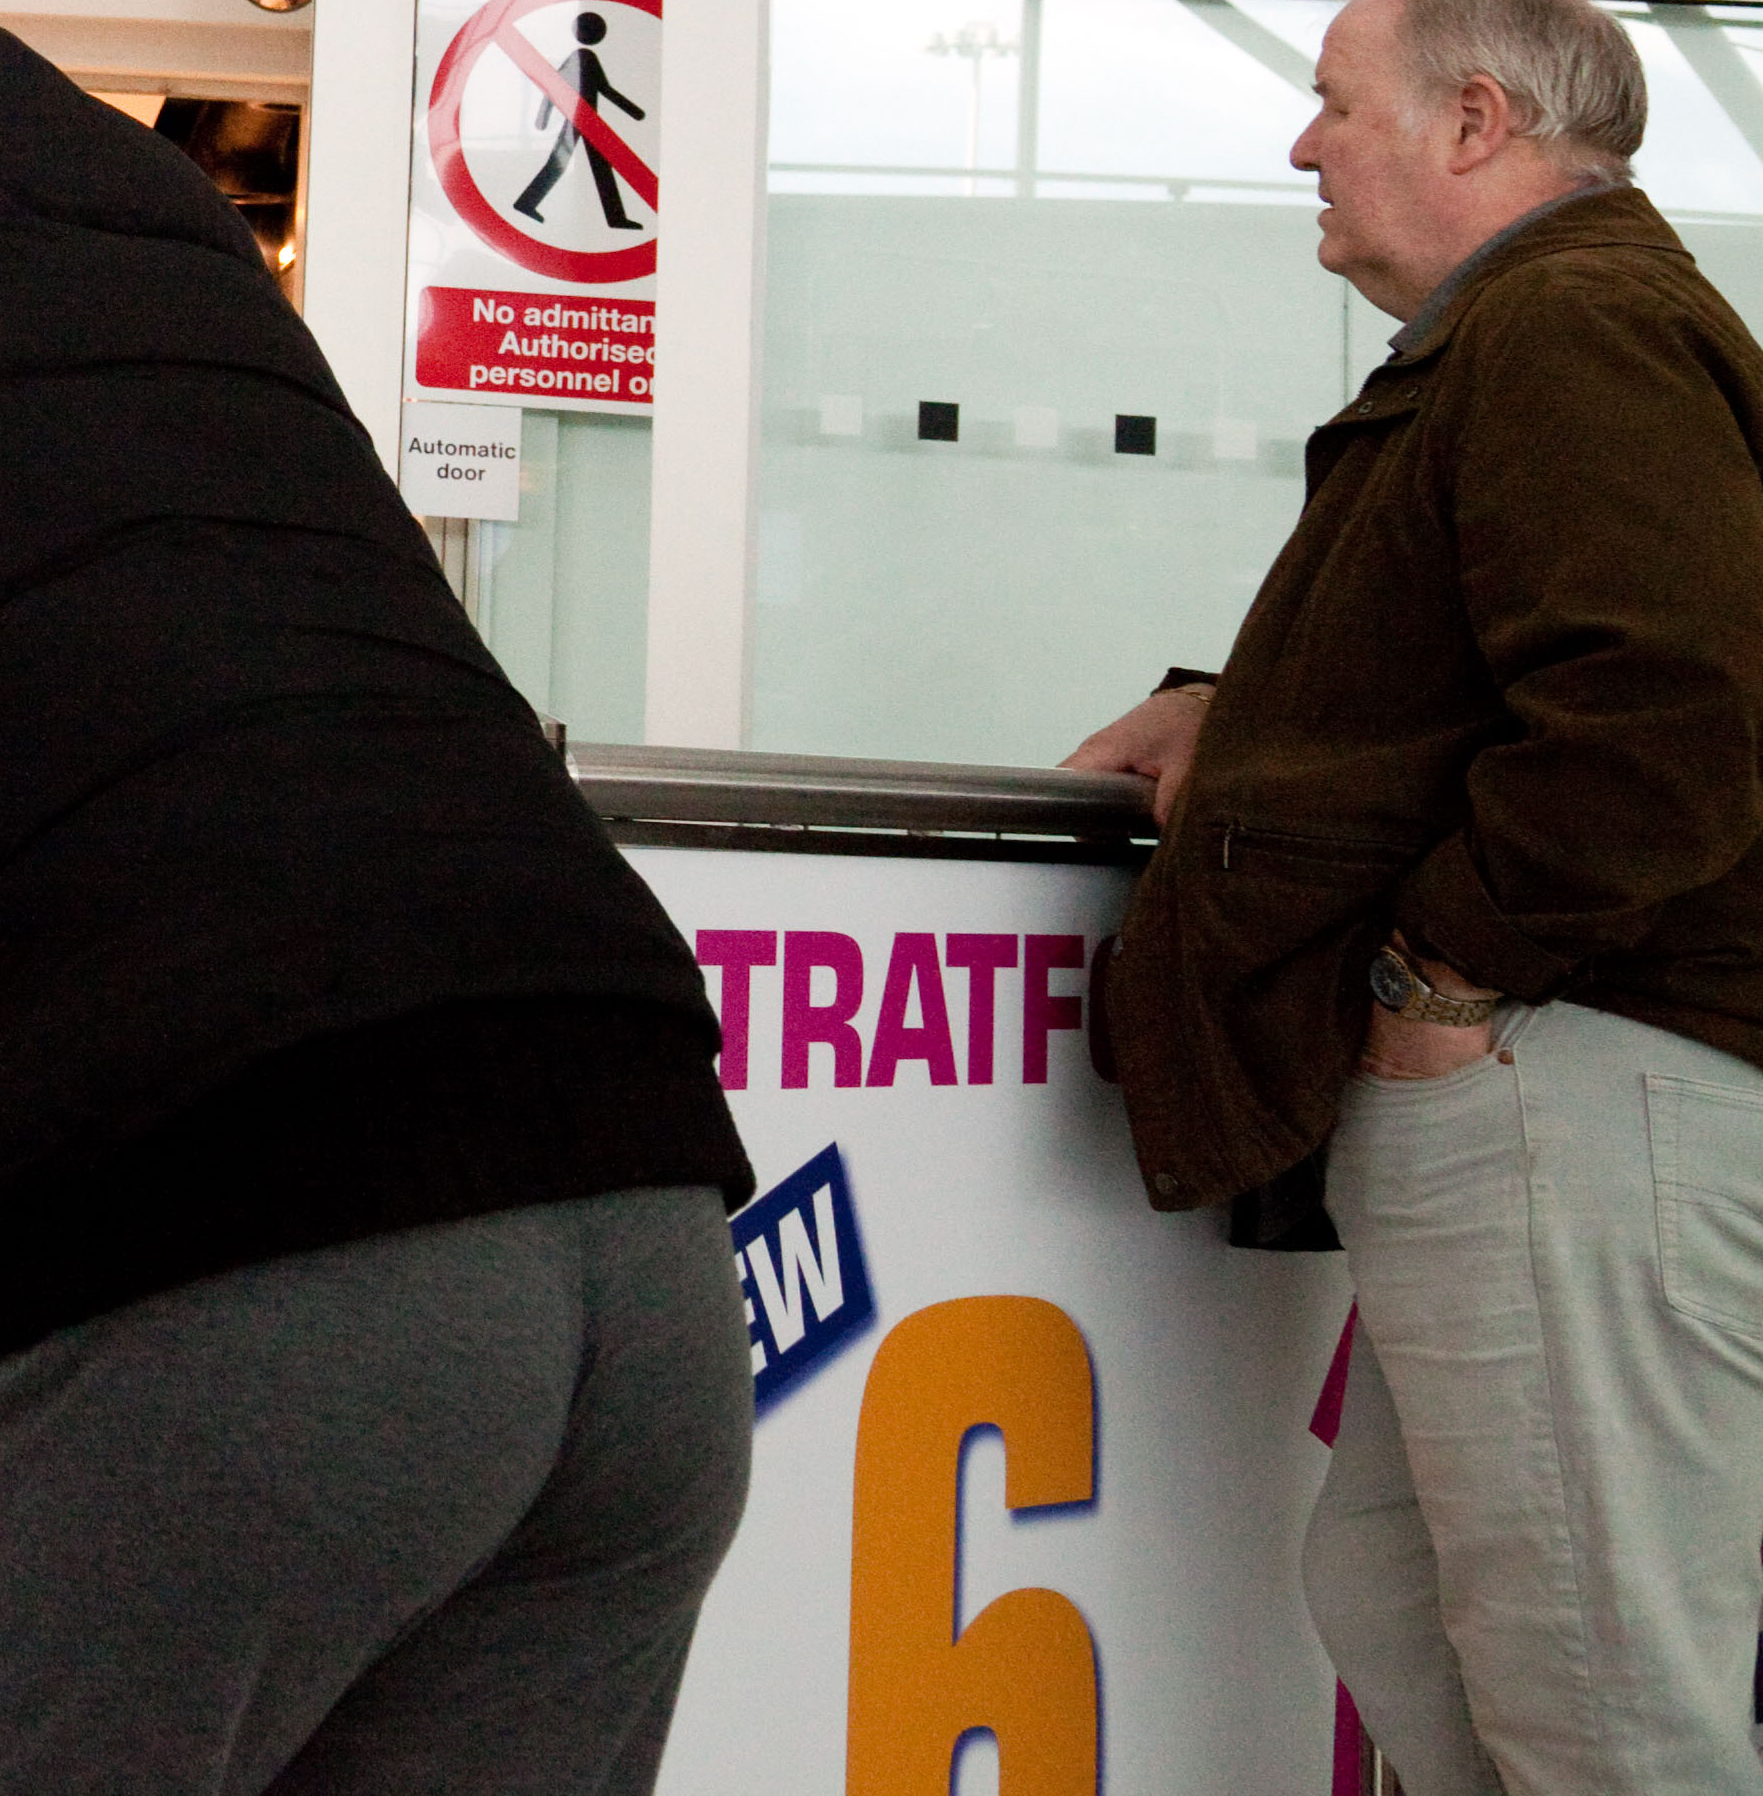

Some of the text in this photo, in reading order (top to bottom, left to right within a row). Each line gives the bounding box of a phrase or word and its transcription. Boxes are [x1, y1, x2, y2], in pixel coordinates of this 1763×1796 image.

[472, 297, 656, 334] No admittan
[468, 363, 621, 394] personnel
[408, 437, 517, 460] Automatic
[436, 462, 486, 482] door
[844, 1294, 1097, 1796] 6
